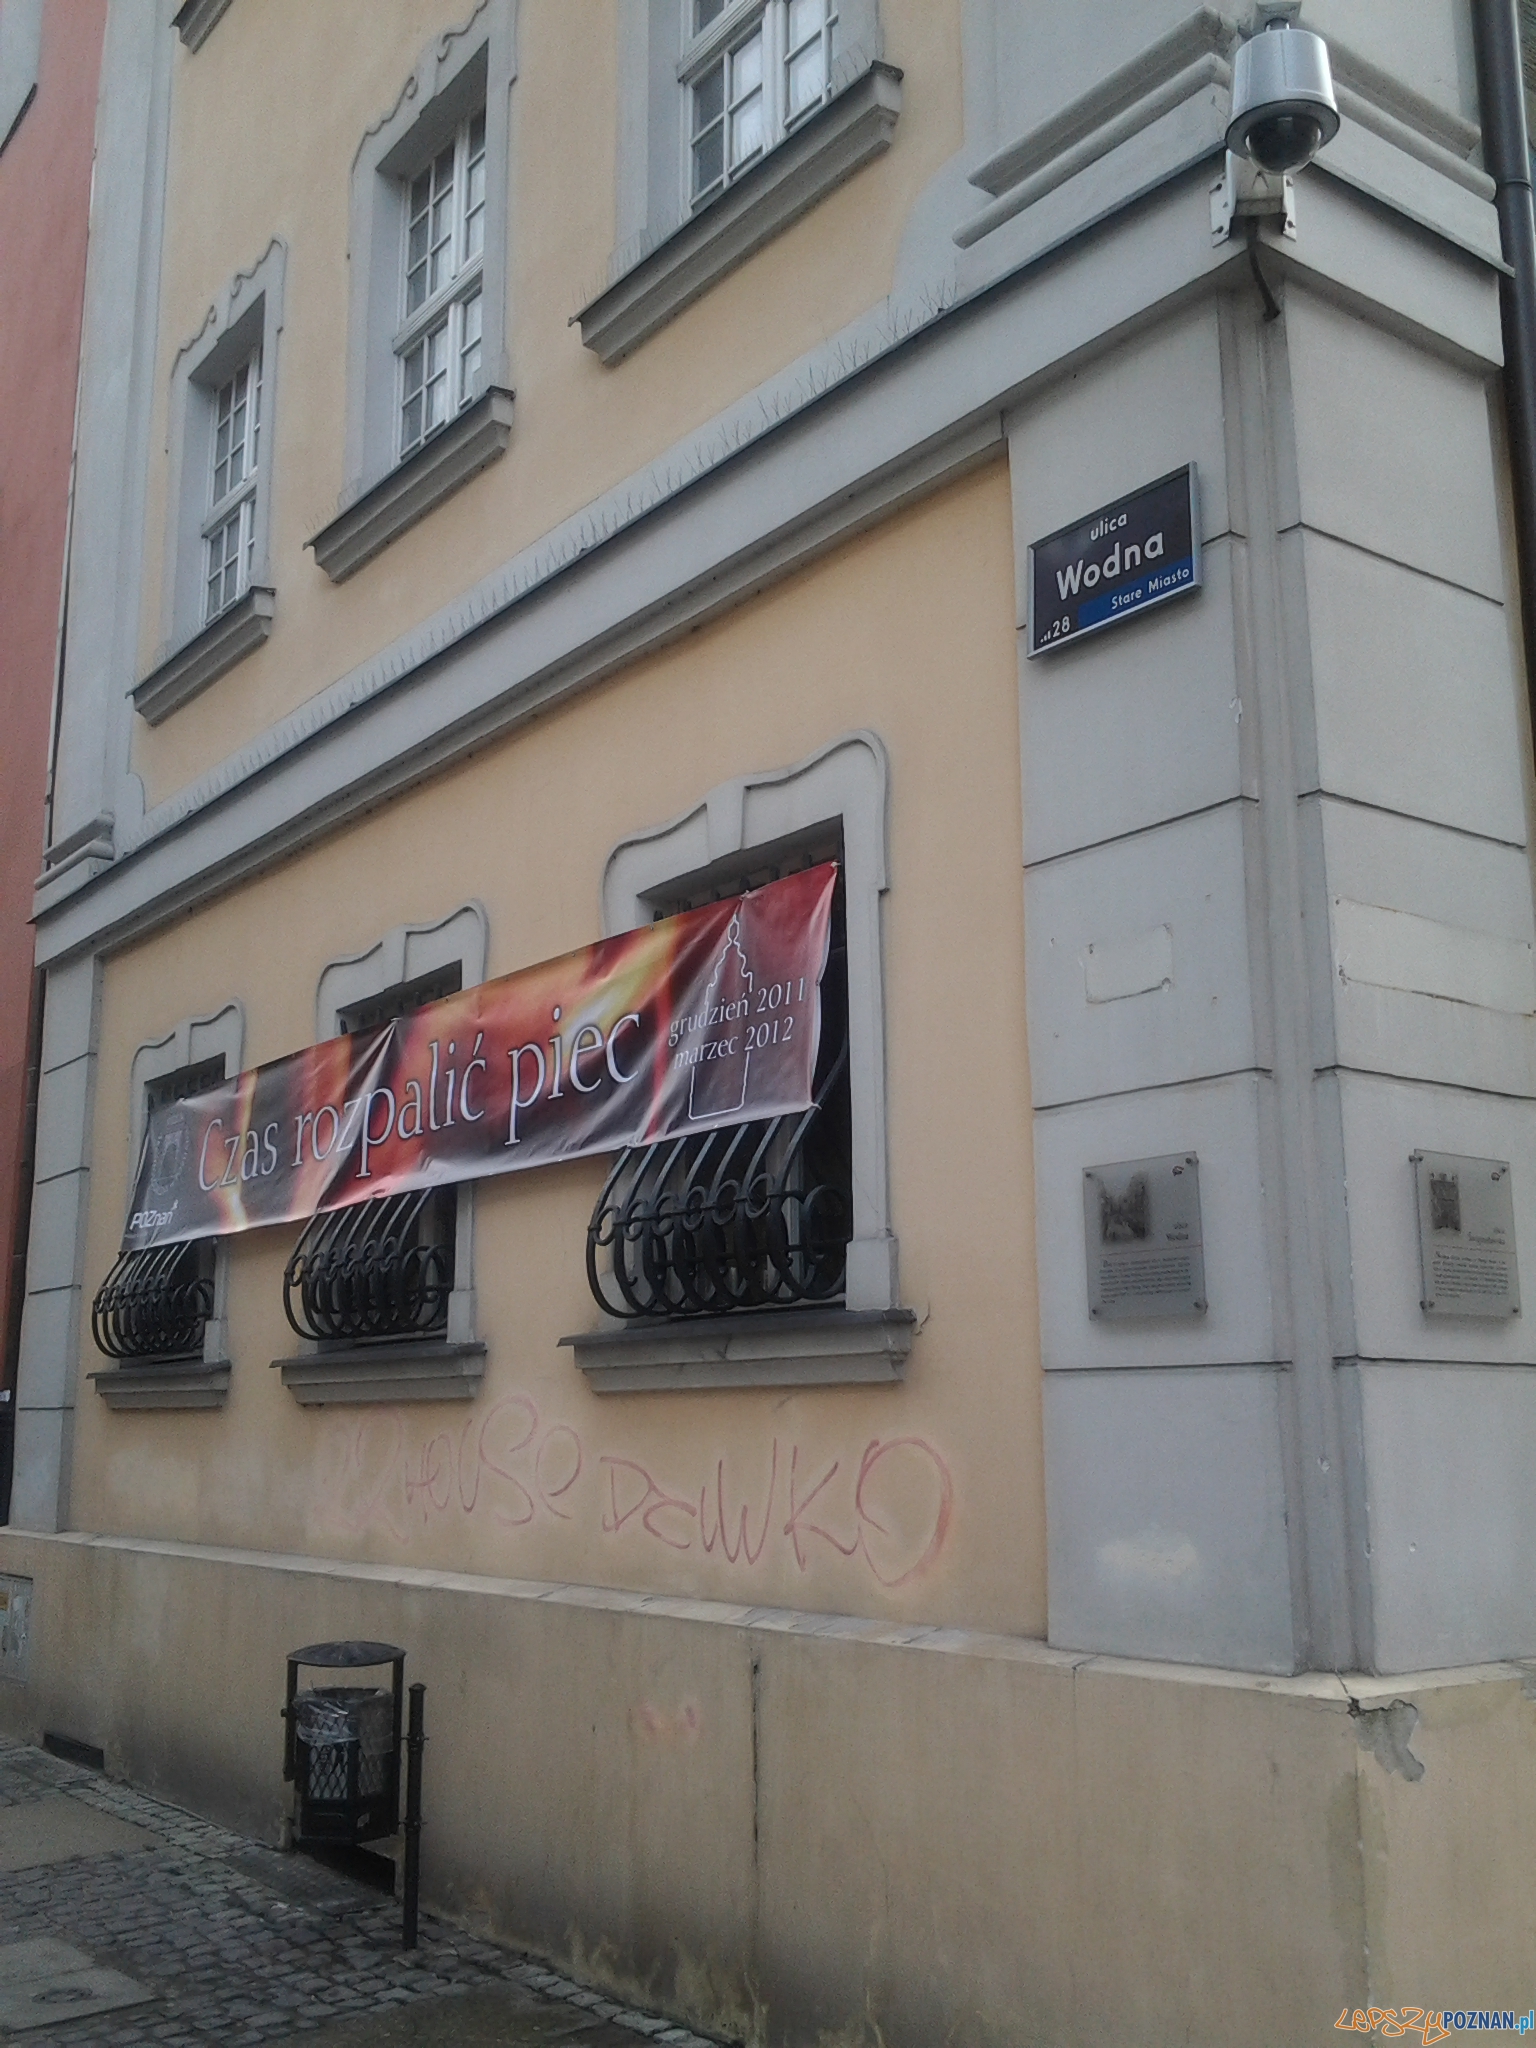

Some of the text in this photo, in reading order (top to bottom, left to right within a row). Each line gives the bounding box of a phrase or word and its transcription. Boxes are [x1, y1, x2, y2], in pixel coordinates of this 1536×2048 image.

[1090, 512, 1128, 541] ulica
[1056, 532, 1164, 600] Wodna
[1111, 567, 1190, 610] Stare Miasto
[668, 978, 807, 1047] grudzień 2011
[673, 1016, 794, 1070] marzec 2012
[198, 1005, 641, 1192] Czas rozpalić piec
